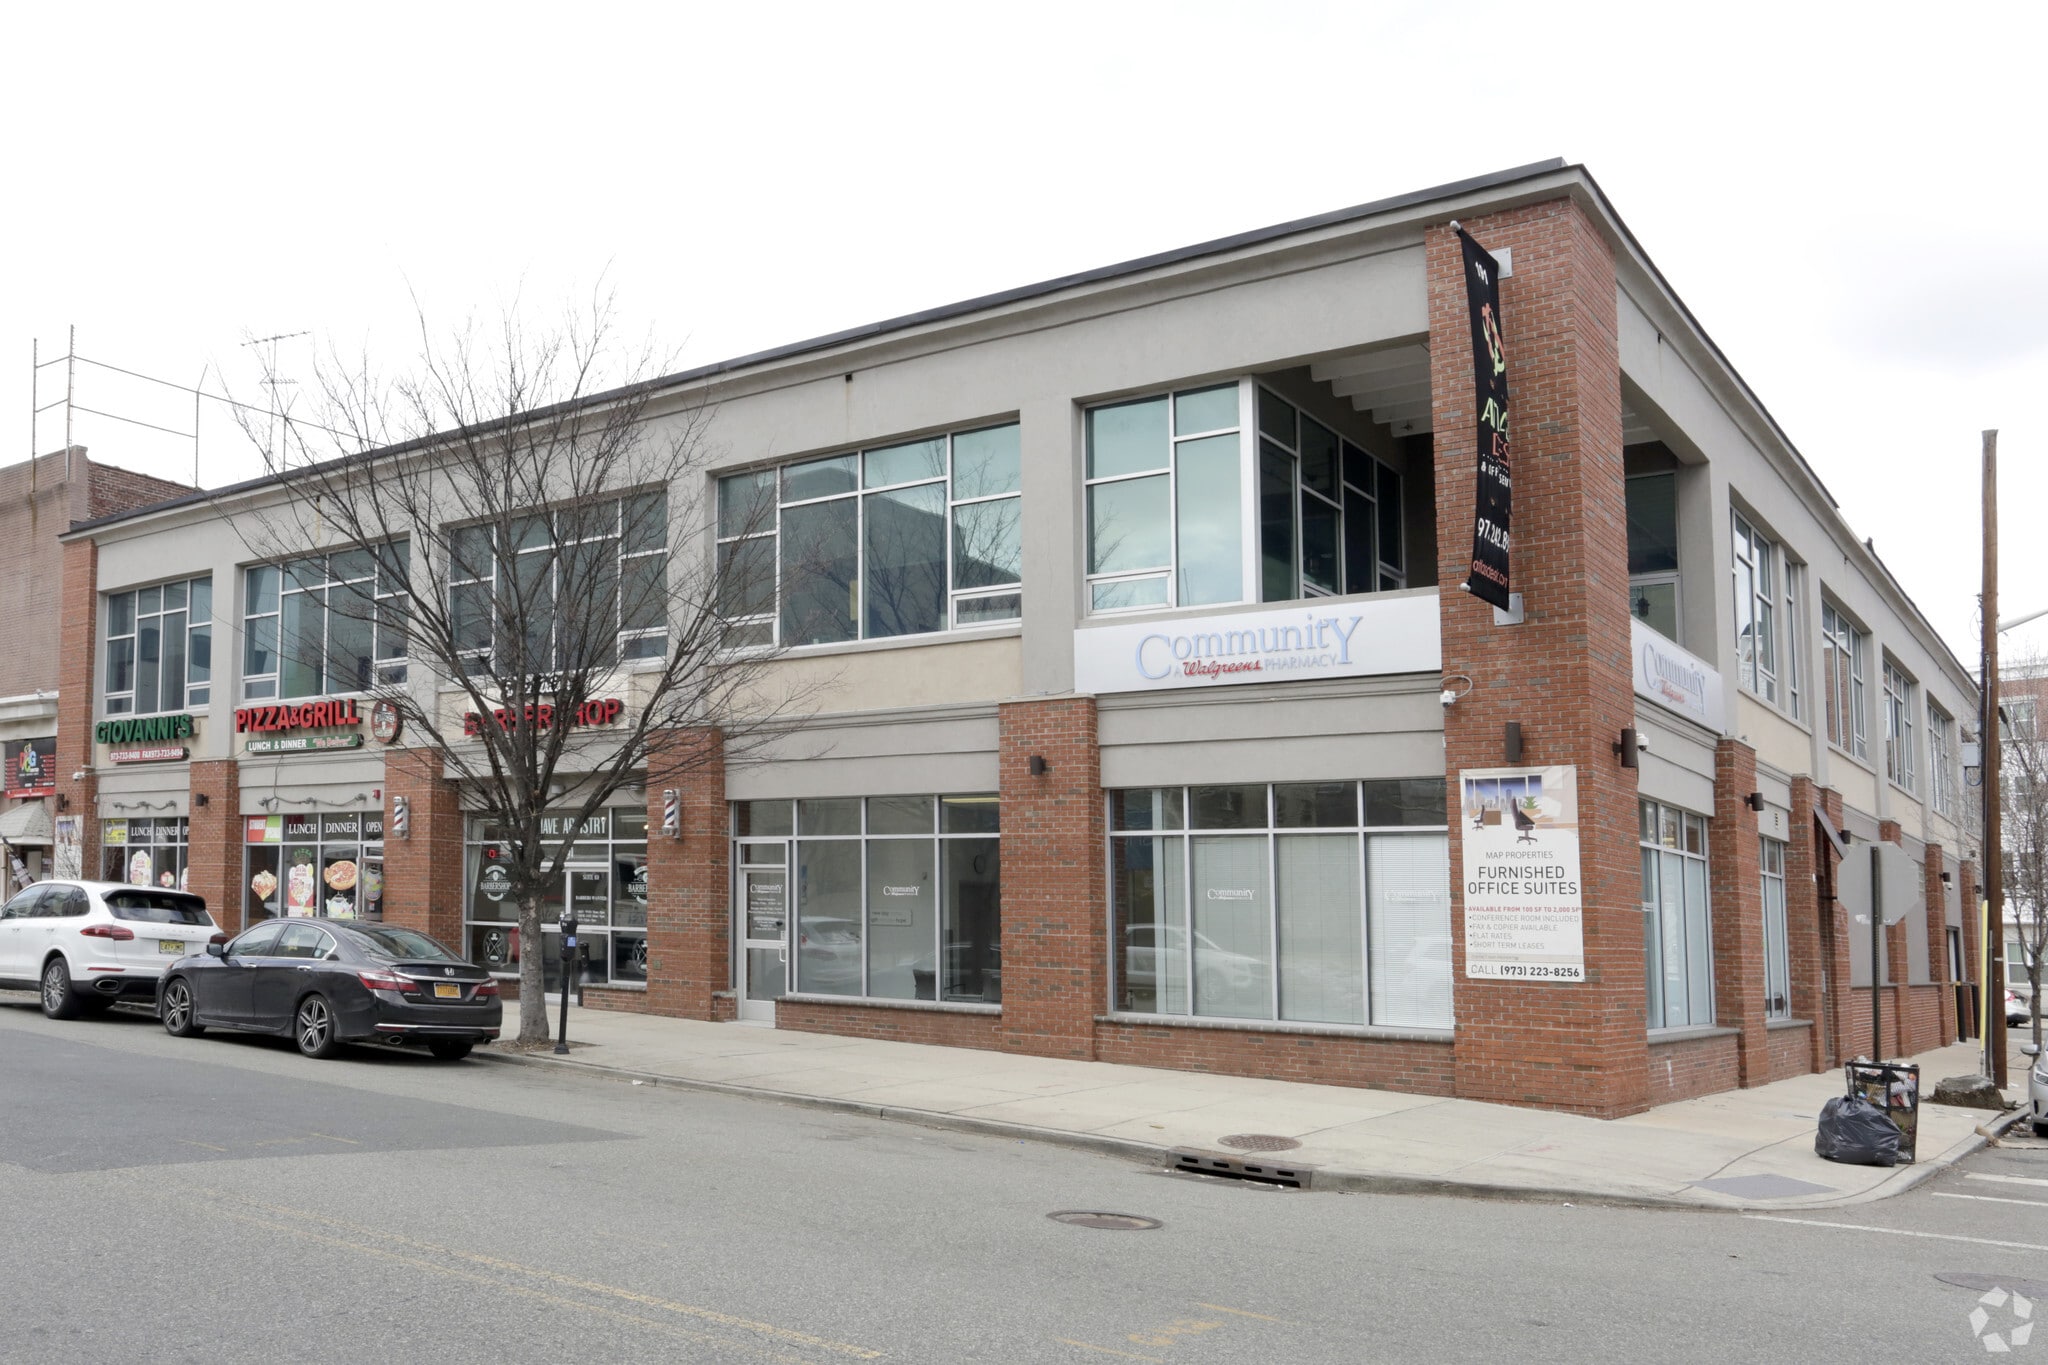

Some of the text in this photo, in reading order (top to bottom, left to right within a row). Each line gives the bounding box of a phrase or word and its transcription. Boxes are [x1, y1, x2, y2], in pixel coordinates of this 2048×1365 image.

[1183, 658, 1261, 680] Walgreens
[1264, 655, 1337, 673] PHARMACY
[96, 714, 192, 744] GIOVANNI'S
[248, 741, 271, 750] LUNCH
[274, 741, 279, 749] &
[281, 739, 307, 749] DINNER
[131, 826, 151, 837] LUNCH
[155, 825, 178, 836] DINNER
[288, 821, 383, 835] LUNCH DINNER OPEN
[1485, 850, 1553, 859] MAP PROPERTIES
[1478, 866, 1565, 879] FURNISHED
[1468, 881, 1577, 895] OFFICE SUITES
[1520, 924, 1558, 932] AVAILABLE
[1518, 942, 1545, 950] LEASES
[1471, 965, 1580, 977] CALL (973) 223-8256
